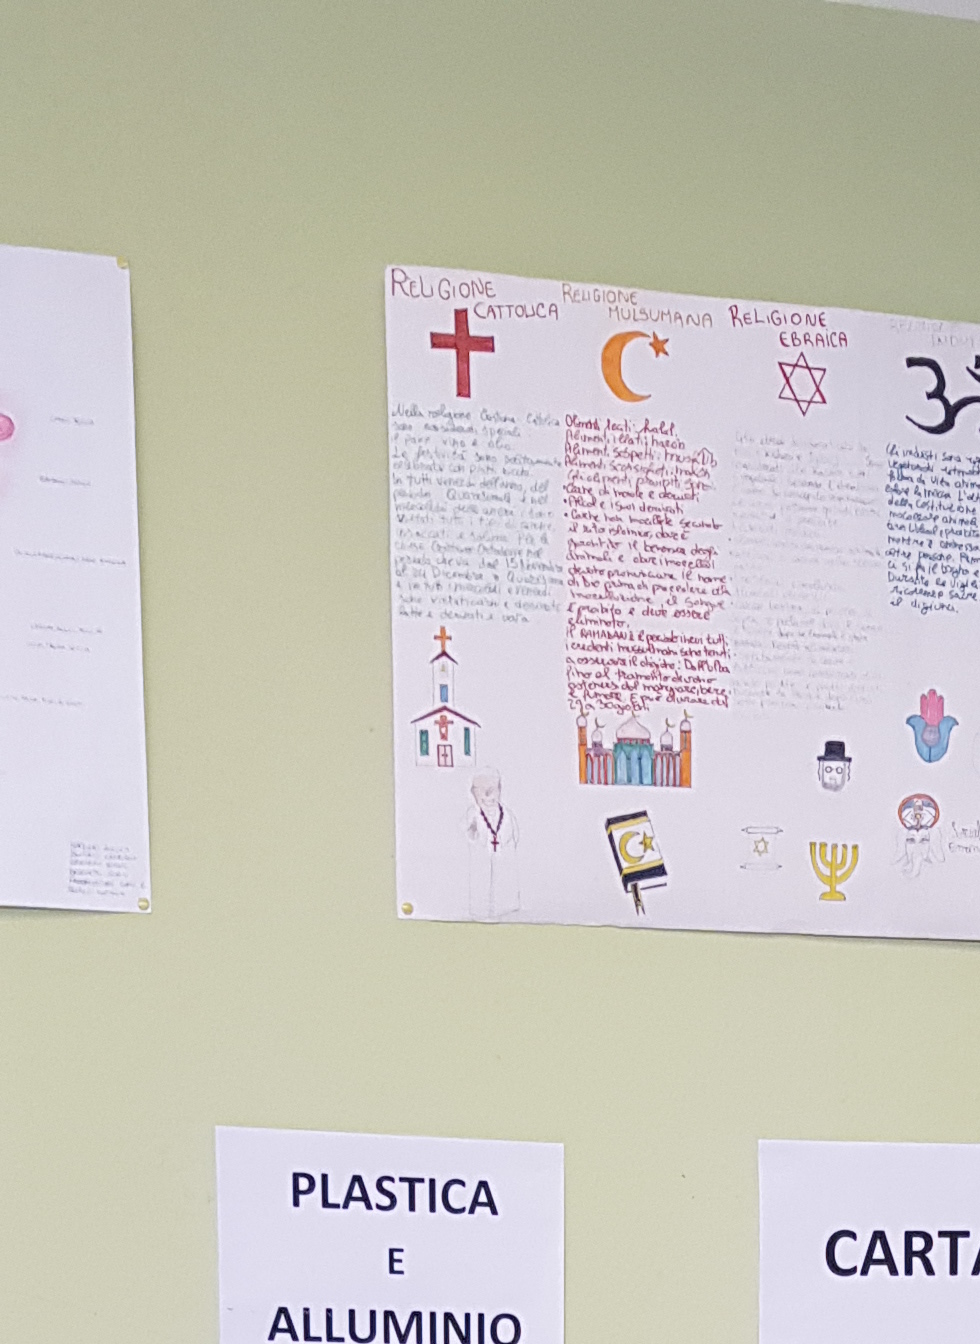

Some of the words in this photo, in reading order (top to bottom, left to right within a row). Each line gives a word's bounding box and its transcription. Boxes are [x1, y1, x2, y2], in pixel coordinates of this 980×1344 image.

[779, 331, 848, 349] EBRAICA
[291, 1171, 499, 1216] PLASTICA
[387, 1247, 405, 1275] E
